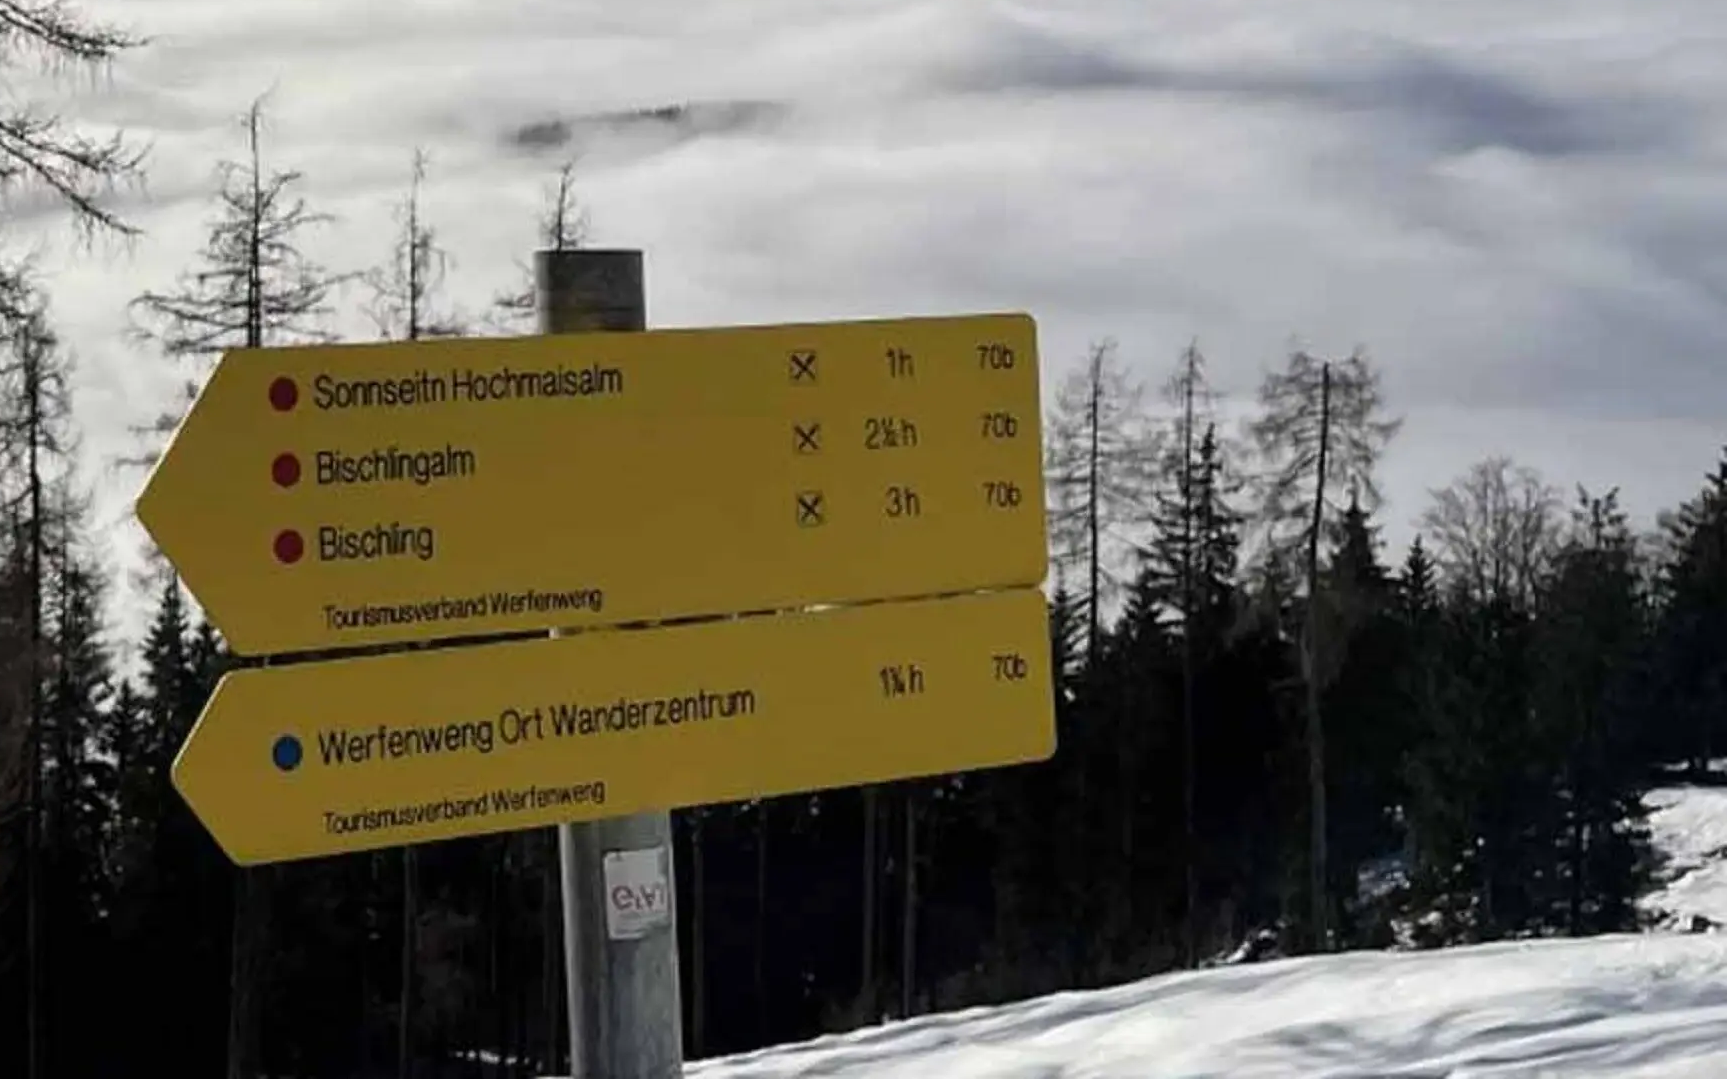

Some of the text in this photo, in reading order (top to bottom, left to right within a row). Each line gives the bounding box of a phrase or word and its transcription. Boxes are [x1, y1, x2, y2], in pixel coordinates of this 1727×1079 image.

[977, 344, 1015, 370] 70b
[313, 364, 623, 410] Sonnseitn Hochmaisalm
[981, 412, 1018, 439] 70b
[316, 442, 475, 485] Bischlingalm
[983, 481, 1022, 507] 70b
[319, 521, 435, 561] Bischling
[324, 588, 603, 630] Tourismusverband Werfenweng
[318, 688, 755, 765] Werfenweng Ort Wanderzentrum
[324, 780, 605, 834] Tourismusverband Werfenweng
